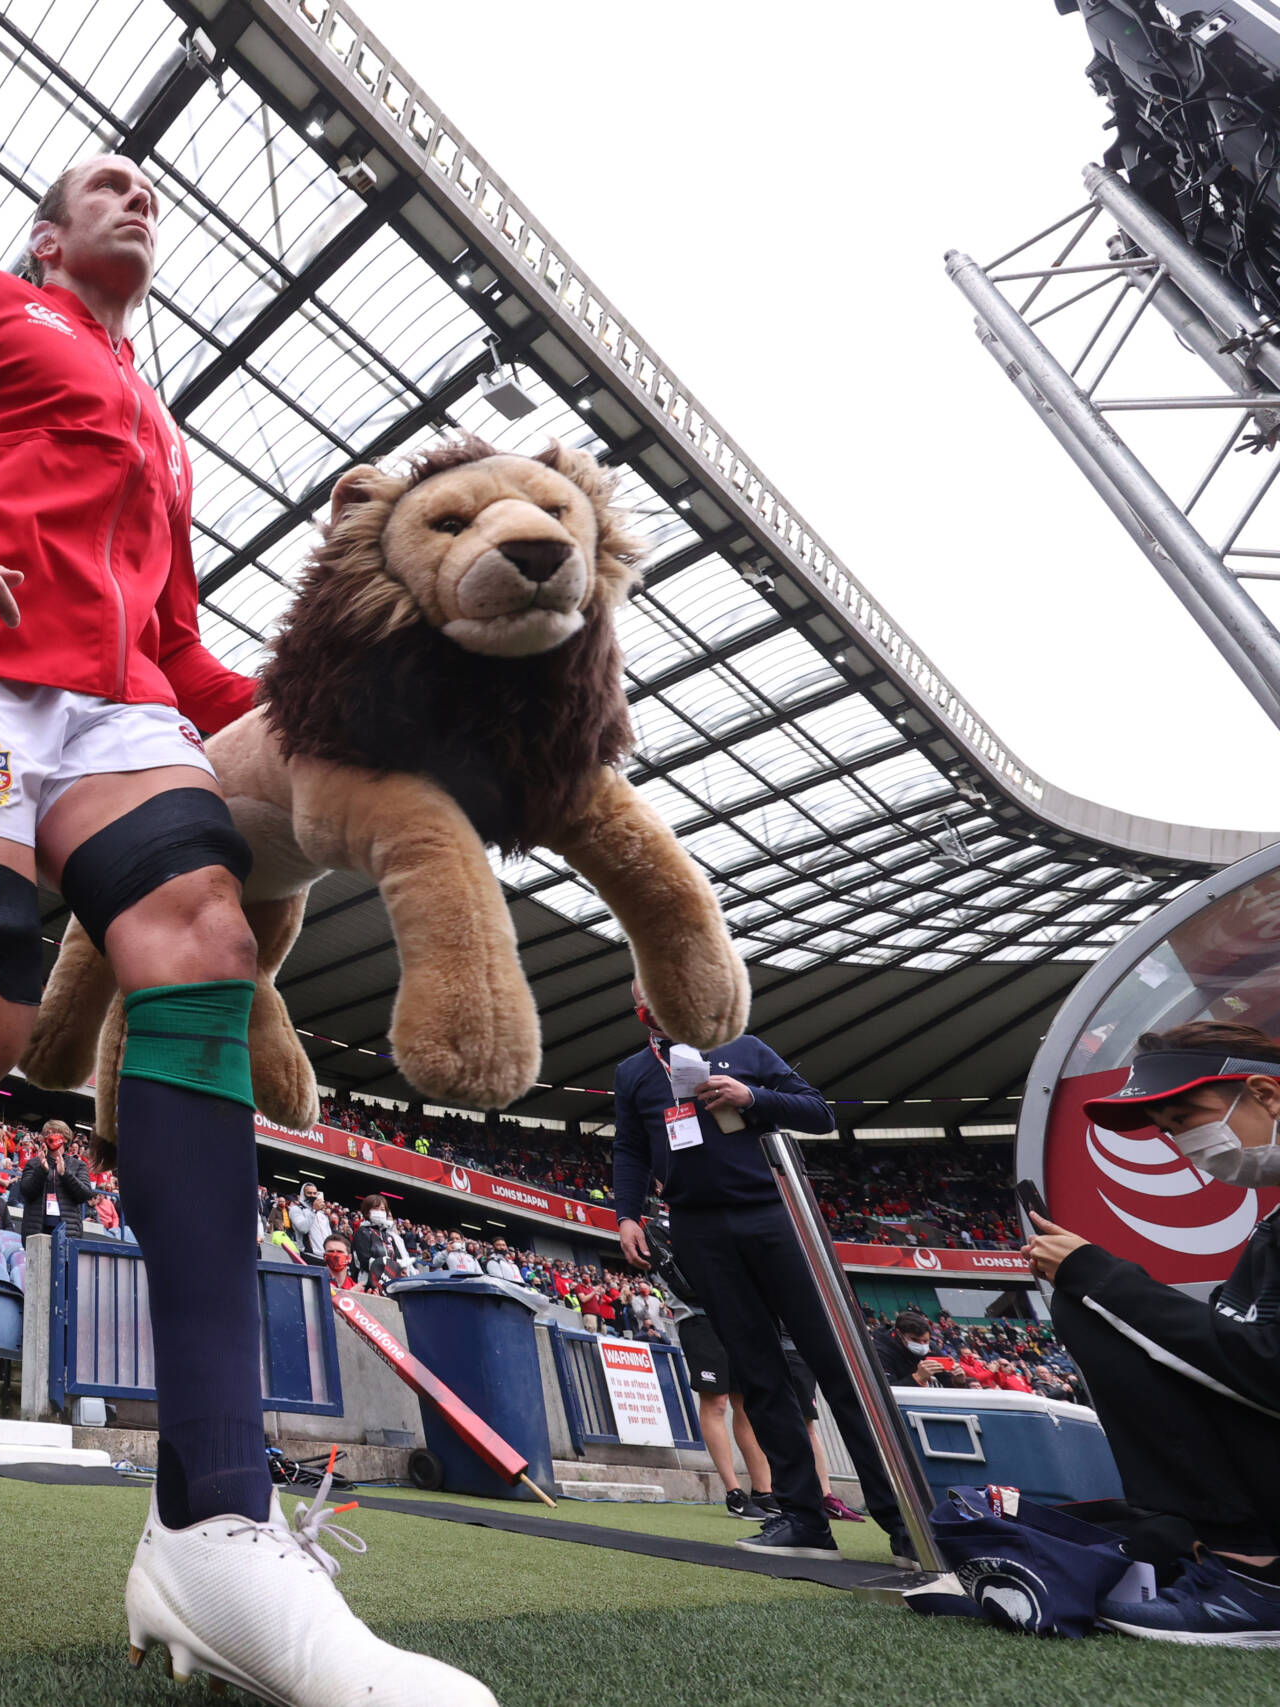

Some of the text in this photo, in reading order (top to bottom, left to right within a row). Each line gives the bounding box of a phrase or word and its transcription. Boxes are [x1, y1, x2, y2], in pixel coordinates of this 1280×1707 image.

[491, 1183, 517, 1201] LIONS
[522, 1194, 549, 1210] JAPAN
[972, 1256, 1013, 1268] LIONS
[354, 1310, 406, 1360] vodafone
[604, 1348, 651, 1369] WARNING
